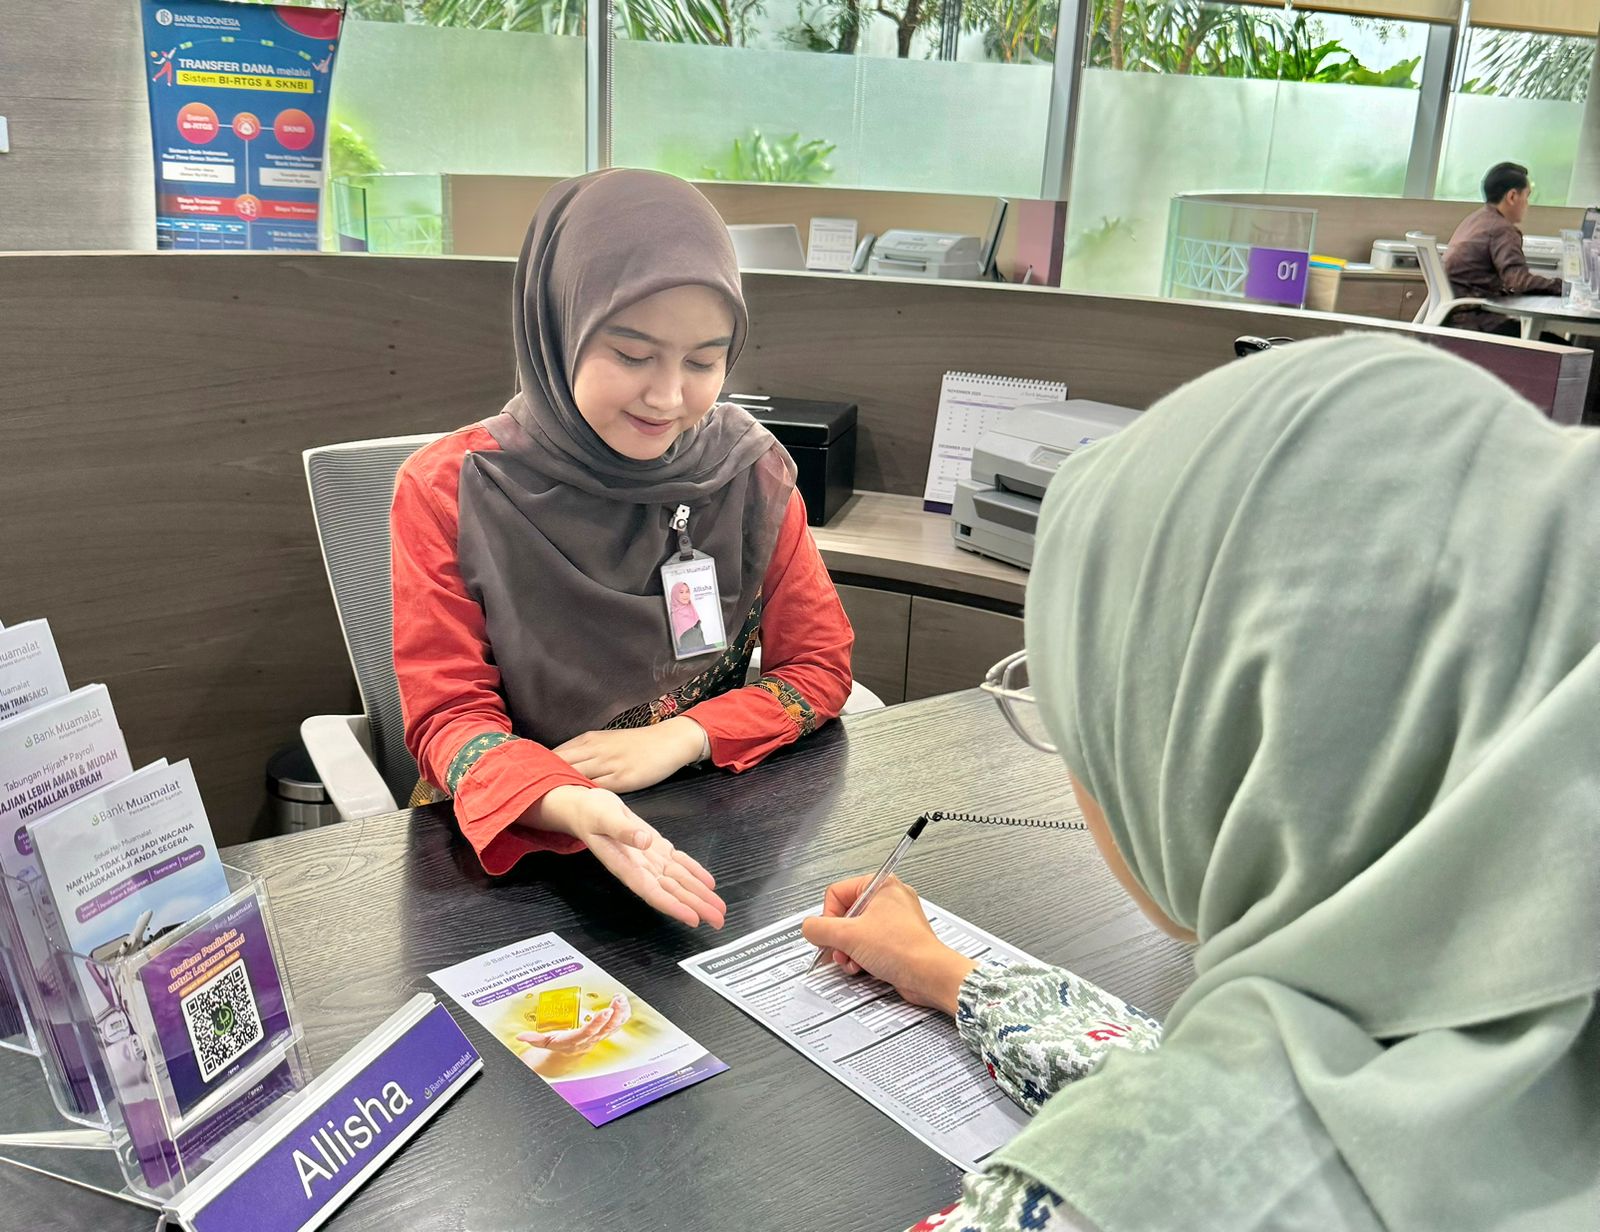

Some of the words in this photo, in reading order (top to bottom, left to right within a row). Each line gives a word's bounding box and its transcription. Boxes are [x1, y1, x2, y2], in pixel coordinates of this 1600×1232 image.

[174, 14, 196, 23] BANK
[197, 16, 241, 27] INDONESIA
[178, 58, 240, 72] TRANSFER
[242, 62, 275, 74] DANA
[276, 66, 311, 77] melalui
[182, 73, 215, 84] Sistem
[219, 76, 262, 87] BI-RTGS
[275, 80, 308, 90] SKNBI
[1277, 261, 1298, 281] 01
[0, 641, 40, 662] uamalat
[10, 686, 49, 709] TRANSAKSI
[33, 726, 56, 745] Bank
[56, 708, 101, 735] Muamalat
[4, 769, 42, 793] Tabungan
[69, 743, 95, 762] Payroll
[27, 780, 52, 801] LEBIH
[52, 767, 78, 789] AMAN
[78, 764, 87, 776] &
[86, 748, 118, 772] MUDAH
[18, 787, 69, 820] INSYAALLAH
[69, 770, 103, 794] BERKAH
[99, 803, 125, 822] Bank
[126, 780, 181, 810] Muamalat
[66, 876, 85, 893] NAIK
[84, 868, 101, 883] HAJI
[100, 857, 121, 875] TIDAK
[121, 848, 139, 861] LAGI
[140, 840, 158, 854] JADI
[158, 823, 195, 844] WACANA
[76, 870, 116, 897] WUJUDKAN
[116, 860, 133, 876] HAJI
[133, 850, 158, 867] ANDA
[158, 835, 189, 855] SEGERA
[168, 970, 193, 993] untuk
[192, 949, 226, 976] Layanan
[224, 932, 246, 954] Kami
[491, 954, 511, 965] Bank
[510, 940, 552, 956] Muamalat
[706, 950, 747, 971] FORMULIR
[745, 934, 788, 956] PENGAJUAN
[787, 928, 803, 939] CIC
[461, 980, 503, 999] WUJUDKAN
[503, 970, 530, 984] IMPIAN
[529, 962, 552, 974] TANPA
[551, 955, 575, 966] CEMAS
[429, 1075, 446, 1093] Bank
[443, 1051, 472, 1080] Muamalat
[291, 1081, 414, 1200] Allisha
